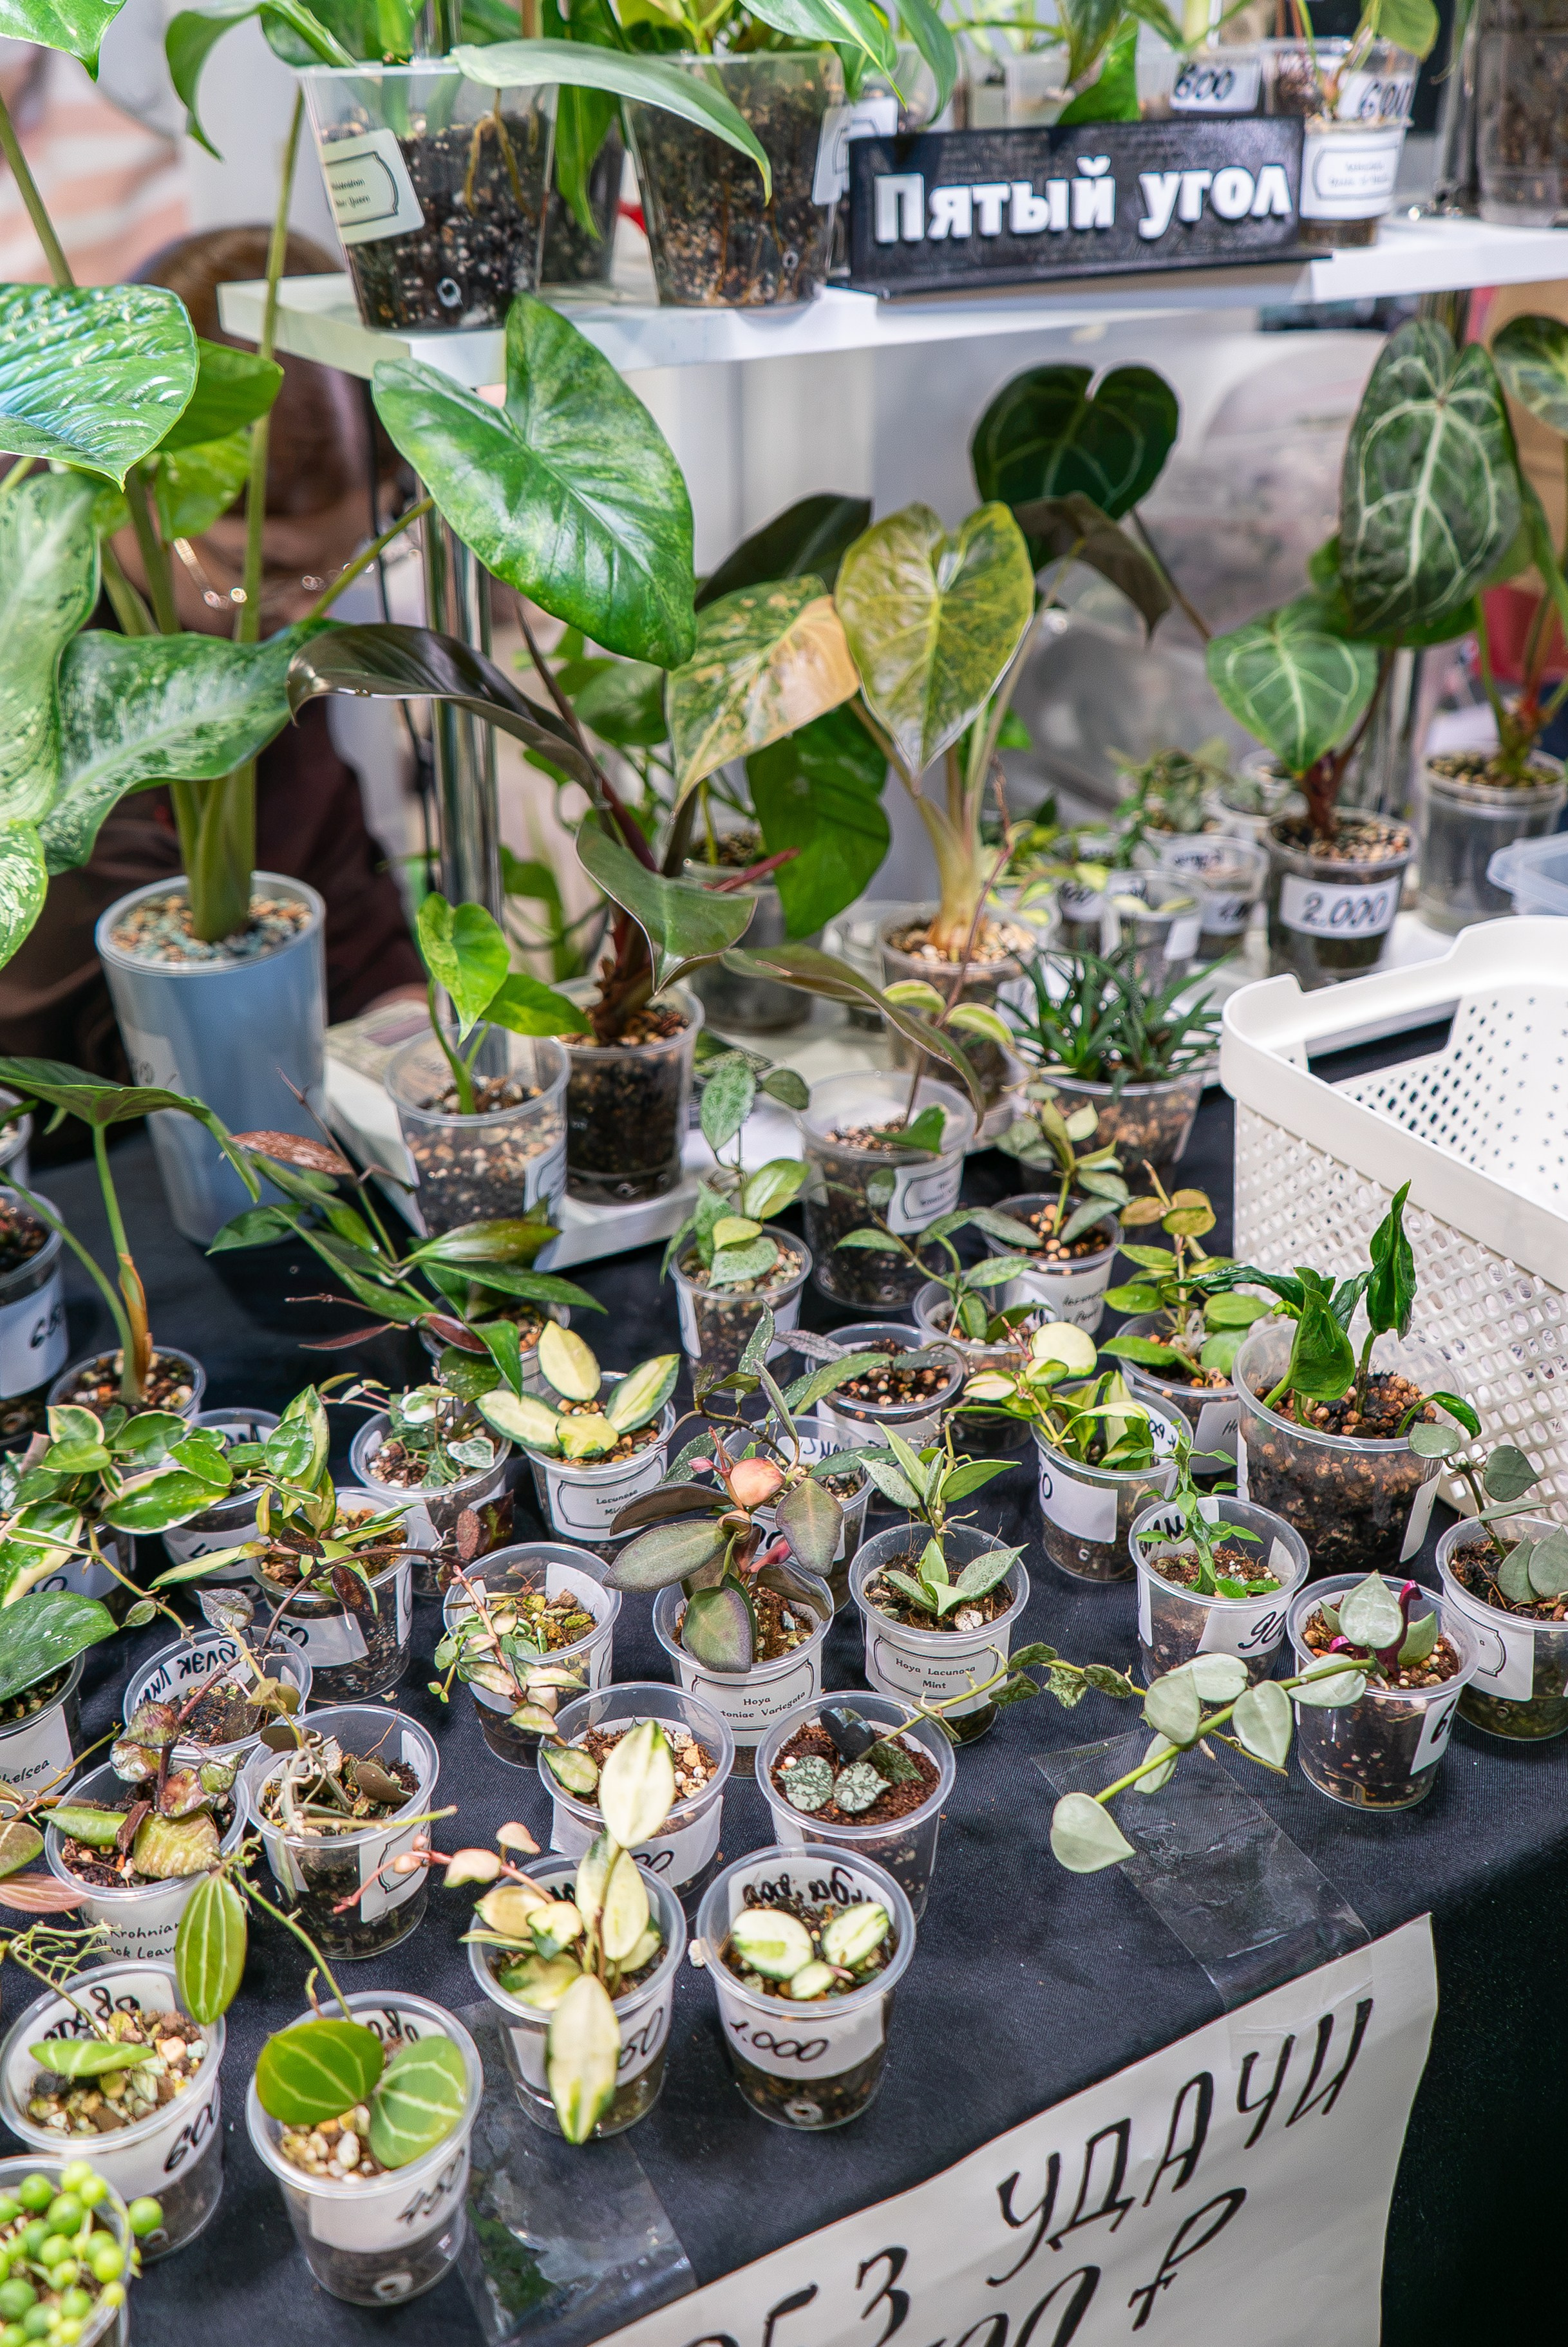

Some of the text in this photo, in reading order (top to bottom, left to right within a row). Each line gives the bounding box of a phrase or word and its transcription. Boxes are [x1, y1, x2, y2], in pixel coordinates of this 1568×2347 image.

[874, 155, 1292, 243] Пятый угол
[1302, 891, 1388, 928] 2.000
[896, 1658, 976, 1676] Hoya Lacunosa
[923, 1680, 947, 1689] Mint
[720, 1691, 806, 1719] toniae Variegata
[743, 1697, 771, 1706] Hoya
[0, 1760, 50, 1784] helsea
[986, 1997, 1374, 2286] УДАЧИ
